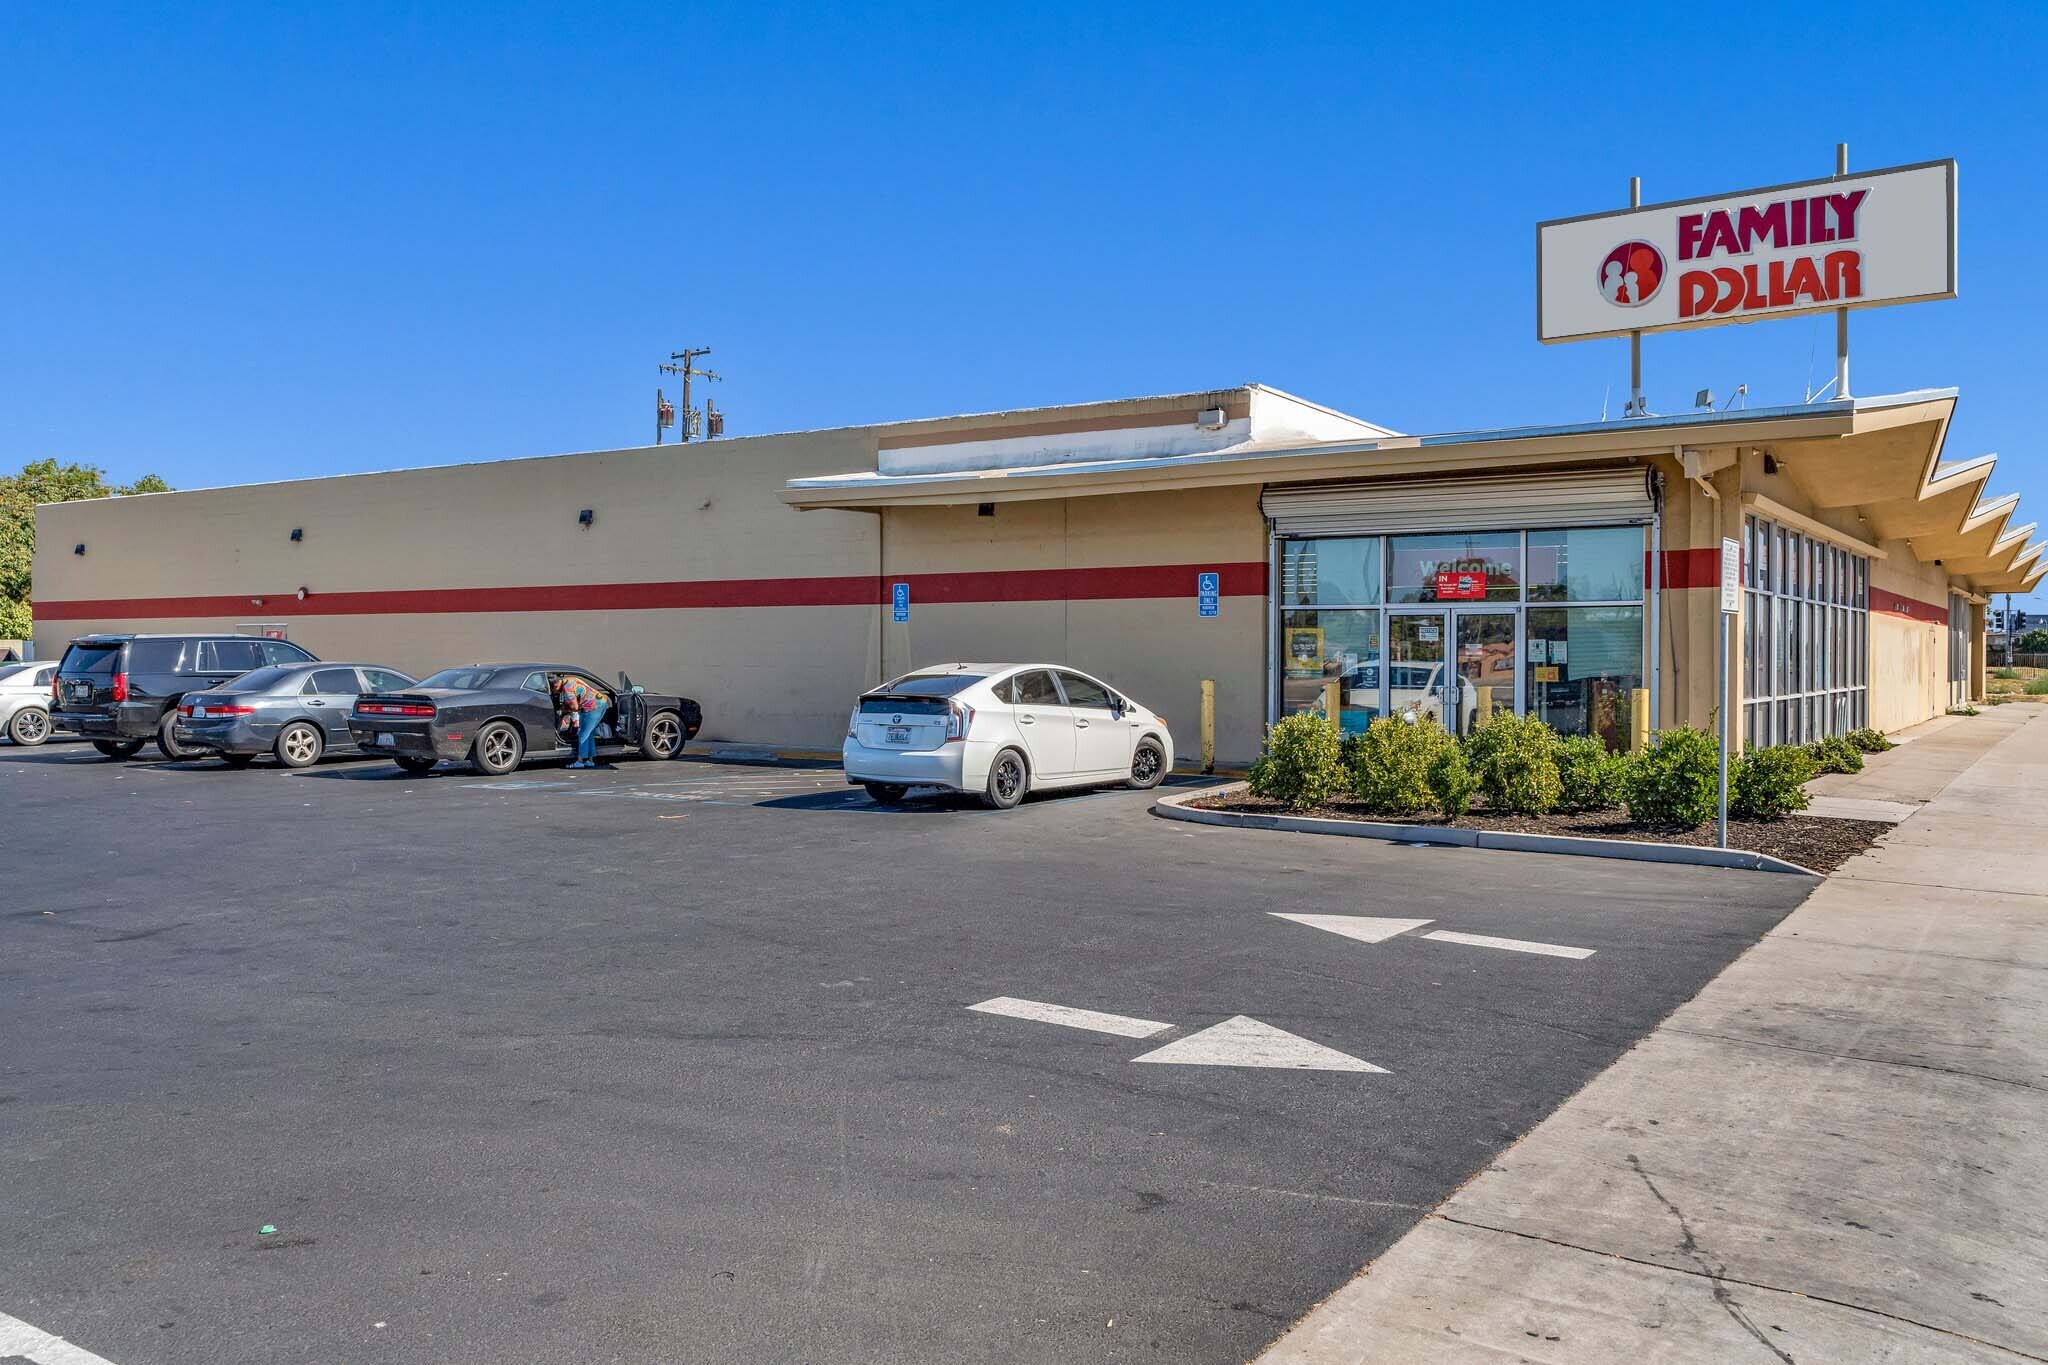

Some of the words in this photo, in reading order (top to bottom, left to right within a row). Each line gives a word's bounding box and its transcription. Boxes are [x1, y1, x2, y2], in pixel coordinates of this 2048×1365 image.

[1678, 189, 1868, 261] FAMILY
[1678, 249, 1863, 319] DOLLAR
[1420, 559, 1513, 577] Welcome
